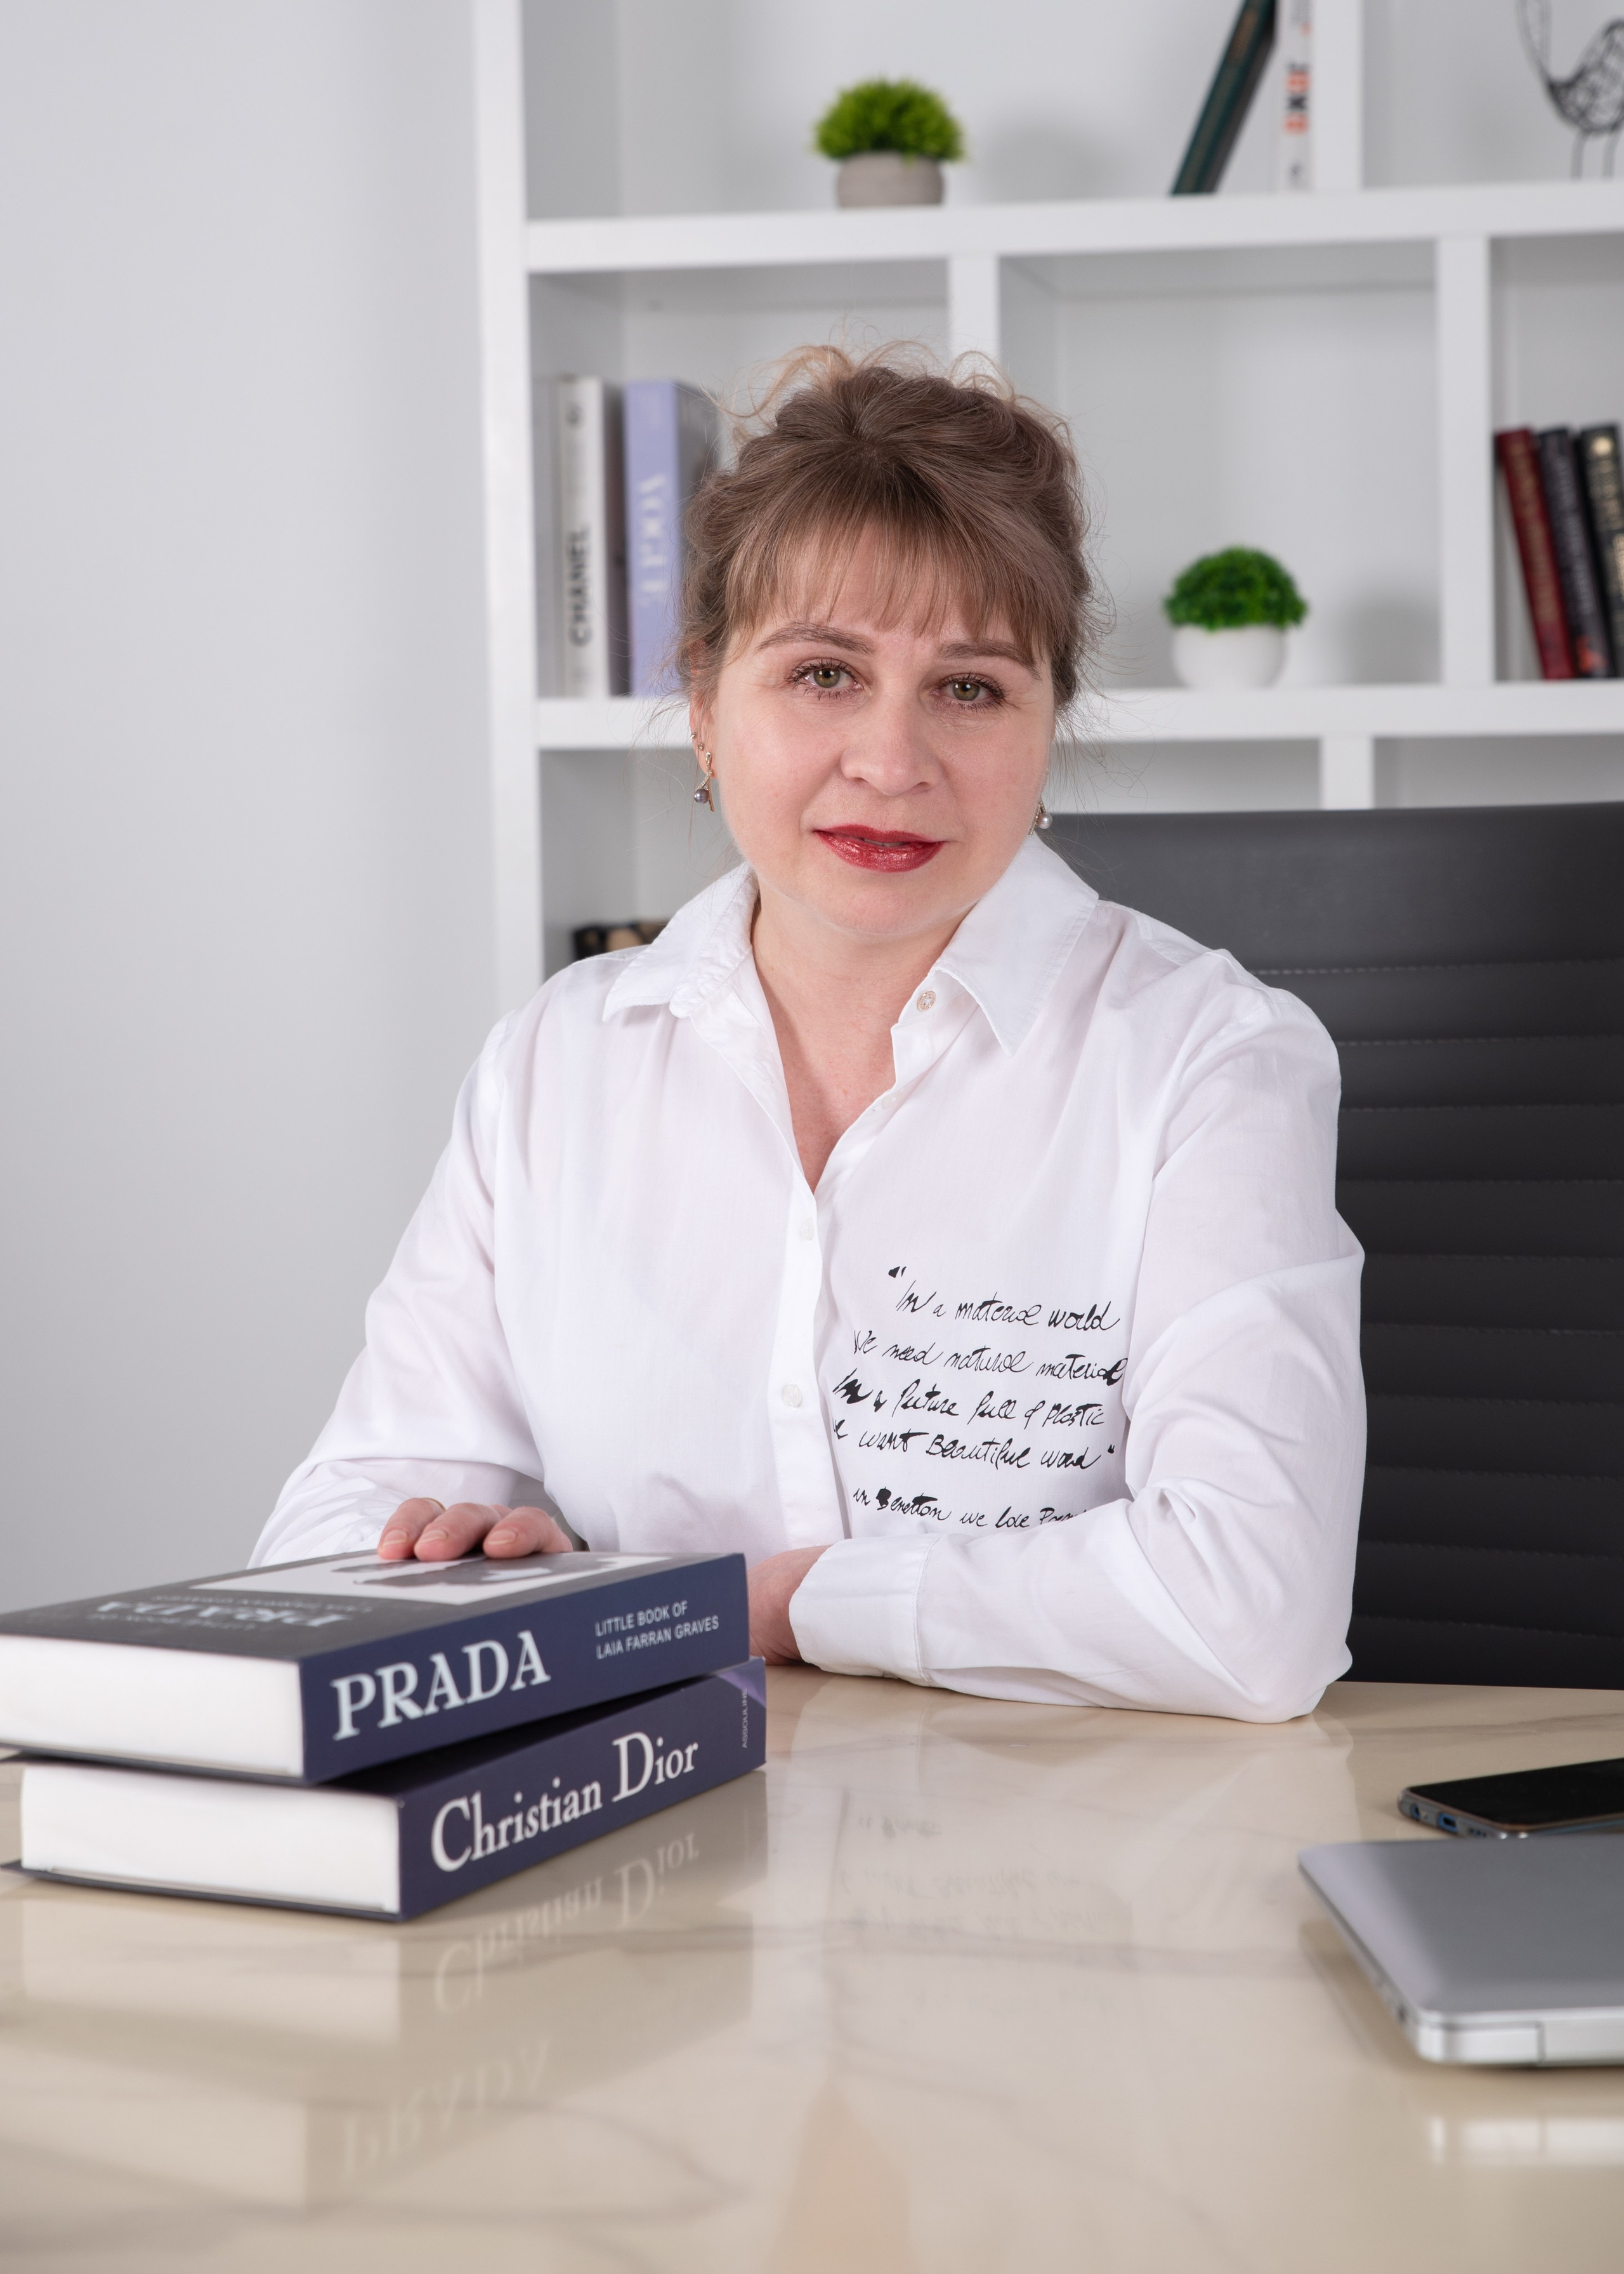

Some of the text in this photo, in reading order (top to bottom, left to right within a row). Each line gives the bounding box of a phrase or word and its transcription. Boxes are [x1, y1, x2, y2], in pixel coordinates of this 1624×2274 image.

[567, 524, 593, 647] CHANEL
[933, 1304, 946, 1317] a
[1047, 1301, 1121, 1331] world
[882, 1343, 944, 1365] need
[943, 1345, 1034, 1373] natural
[891, 1378, 960, 1418] future
[966, 1390, 1018, 1425] full
[858, 1428, 930, 1452] want
[959, 1513, 988, 1527] we
[995, 1506, 1030, 1528] love
[595, 1600, 688, 1638] LITTLE BOOK OF
[596, 1615, 719, 1660] LAIA FARRAN GRAVES
[329, 1630, 551, 1741] PRADA
[741, 1688, 749, 1749] ASSOULINE
[431, 1731, 699, 1872] Christian Dior
